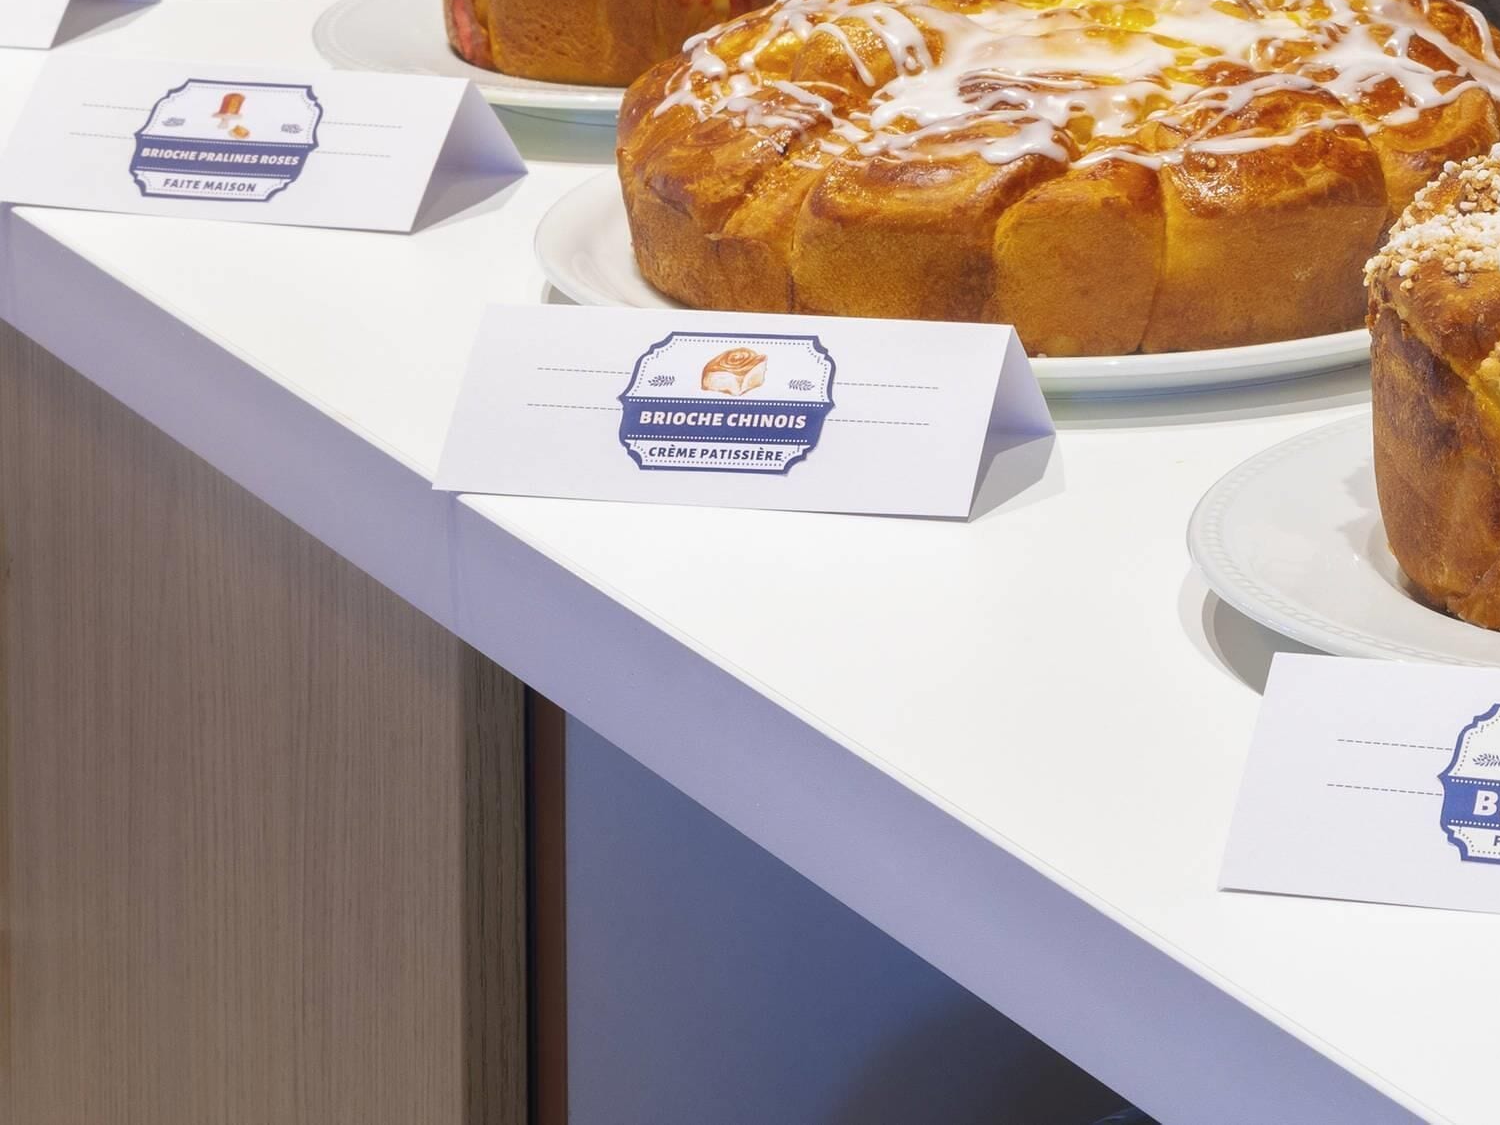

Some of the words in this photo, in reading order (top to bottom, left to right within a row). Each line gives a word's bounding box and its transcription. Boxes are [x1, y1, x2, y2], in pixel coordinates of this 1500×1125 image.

[140, 147, 197, 161] BRIOCHE
[198, 150, 258, 165] PRALINES
[259, 154, 300, 166] ROSES
[163, 178, 201, 190] FAITE
[202, 181, 257, 193] MAISON
[639, 410, 724, 427] BRIOCHE
[726, 412, 808, 429] CHINOIS
[648, 444, 697, 459] CRÈME
[700, 446, 783, 462] PATISSIÈRE
